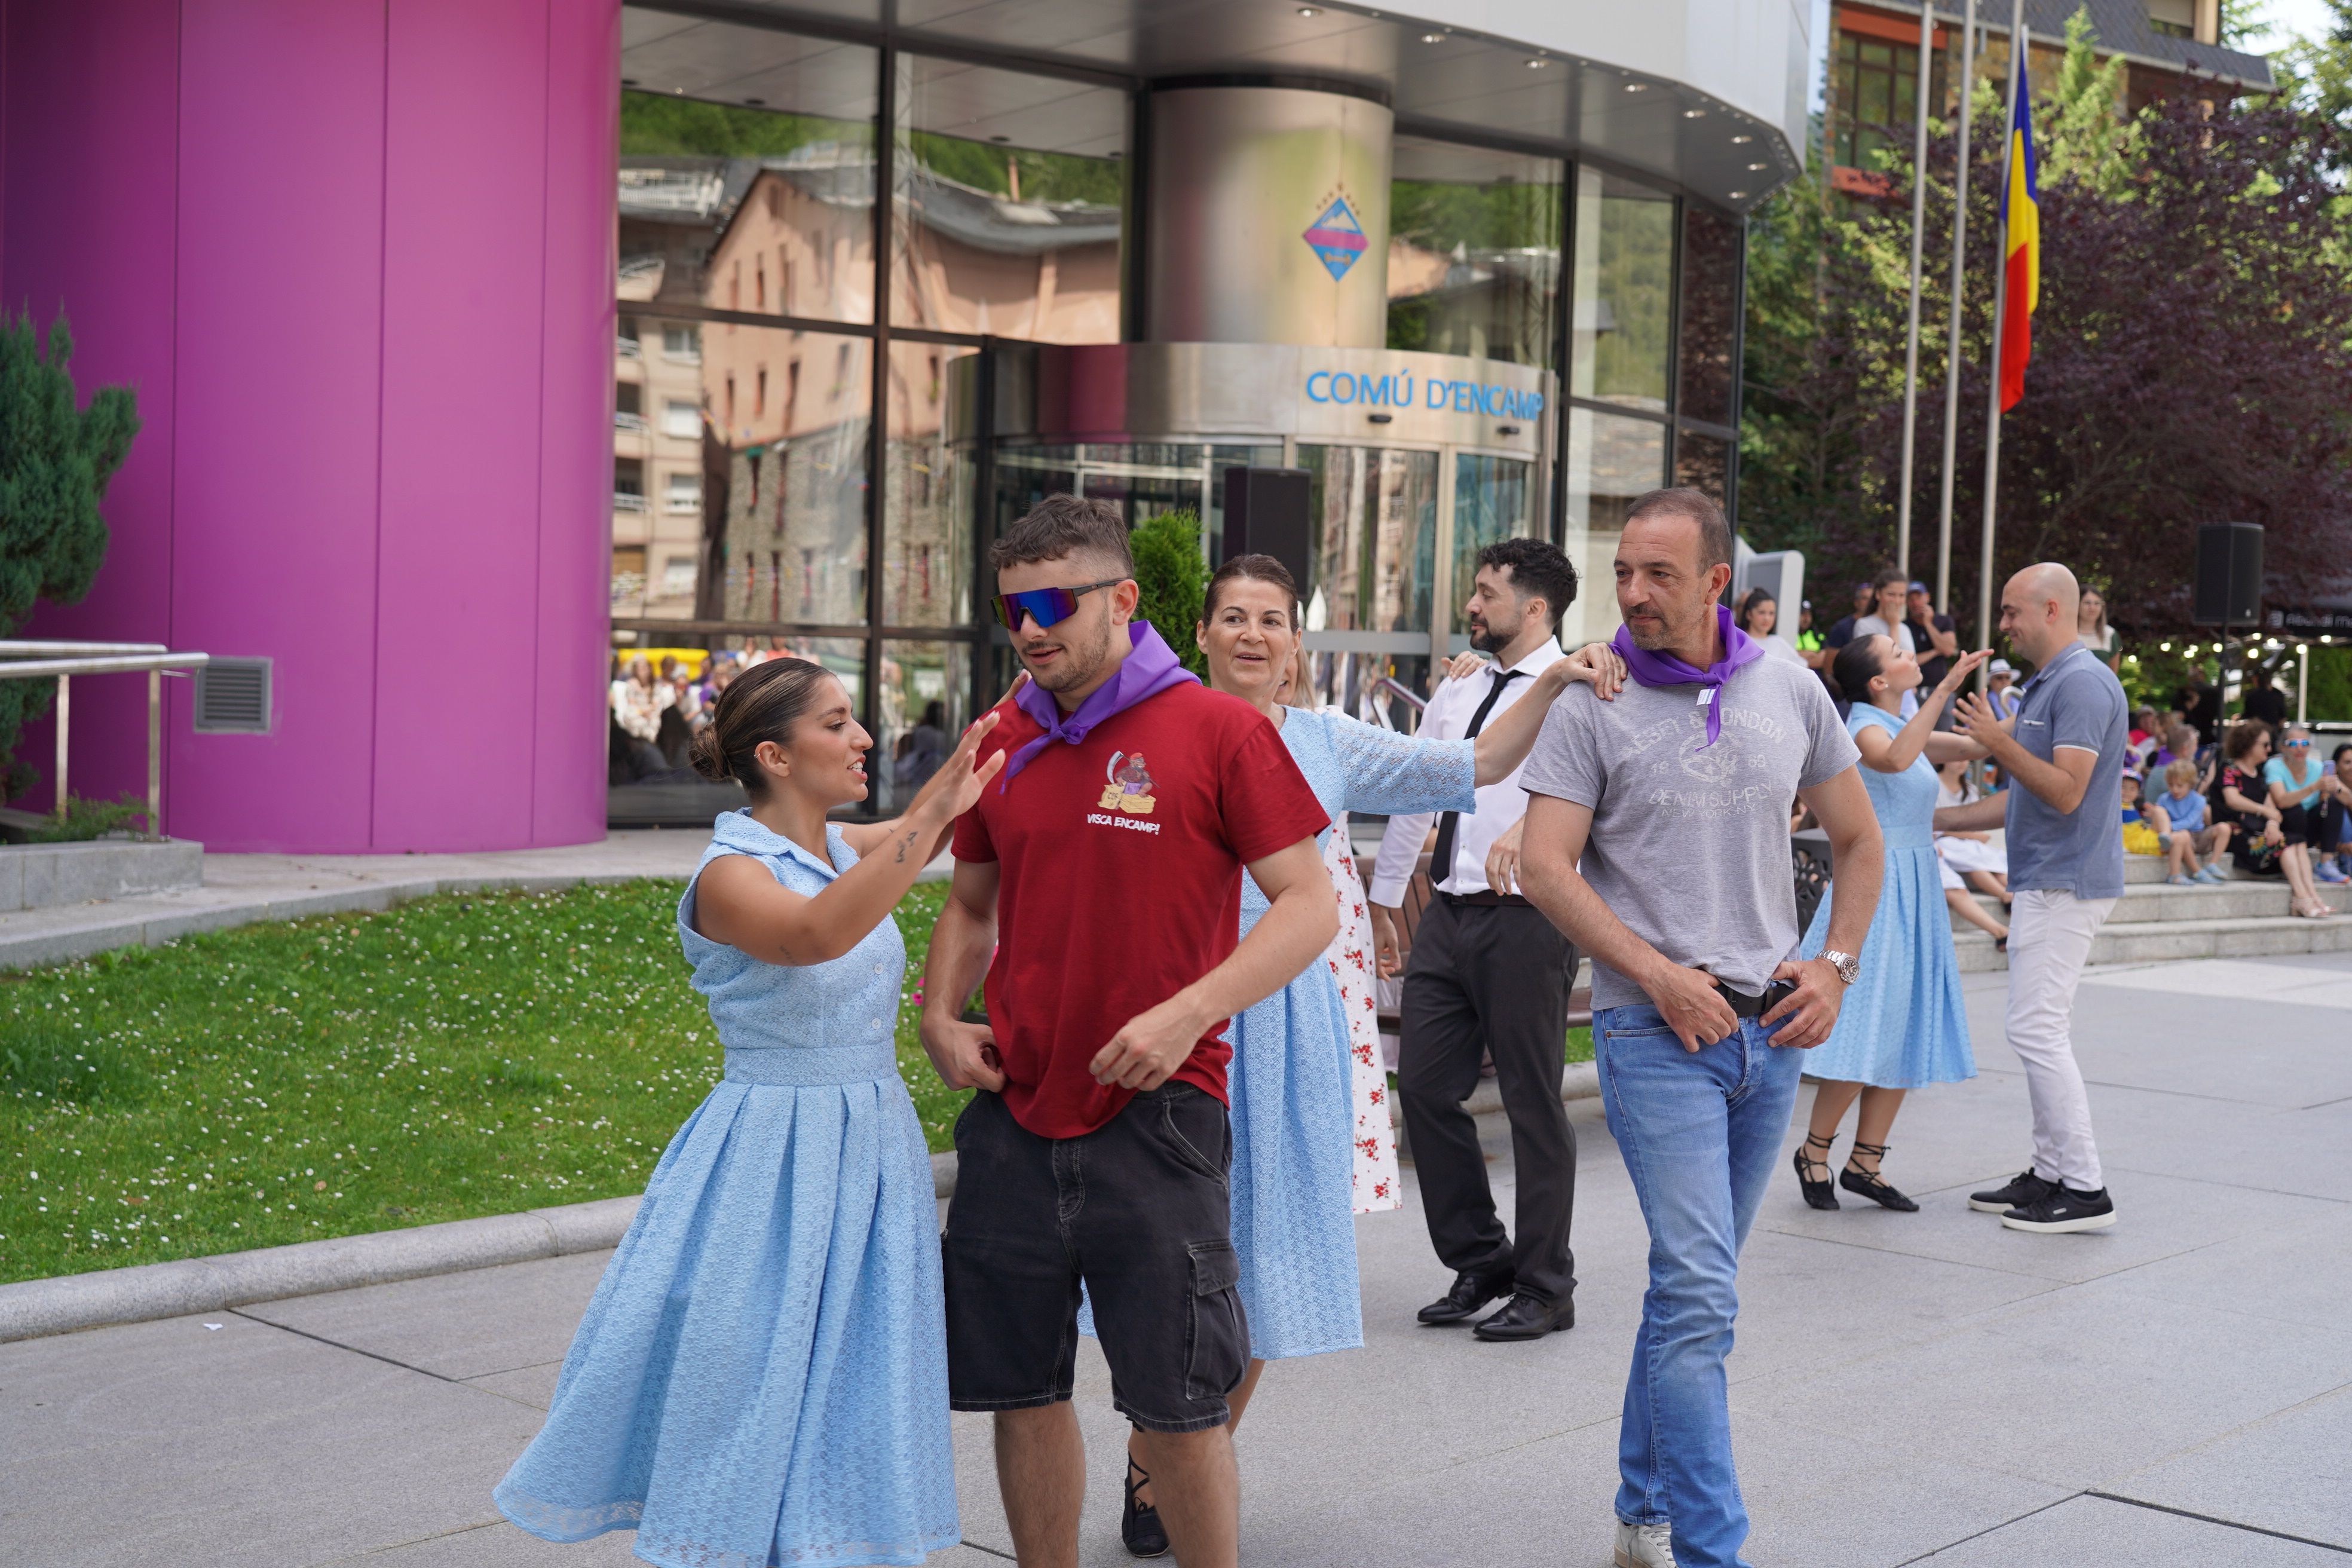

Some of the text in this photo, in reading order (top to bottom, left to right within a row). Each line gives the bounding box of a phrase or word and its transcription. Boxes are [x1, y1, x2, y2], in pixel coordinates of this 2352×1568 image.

[1306, 369, 1544, 422] COMÚ D'ENCAMP
[1720, 707, 1788, 744] ONDON
[1649, 780, 1773, 808] DENIM SUPPLY
[1087, 813, 1160, 835] VISCA ENCAMP!
[1661, 808, 1695, 818] NEW
